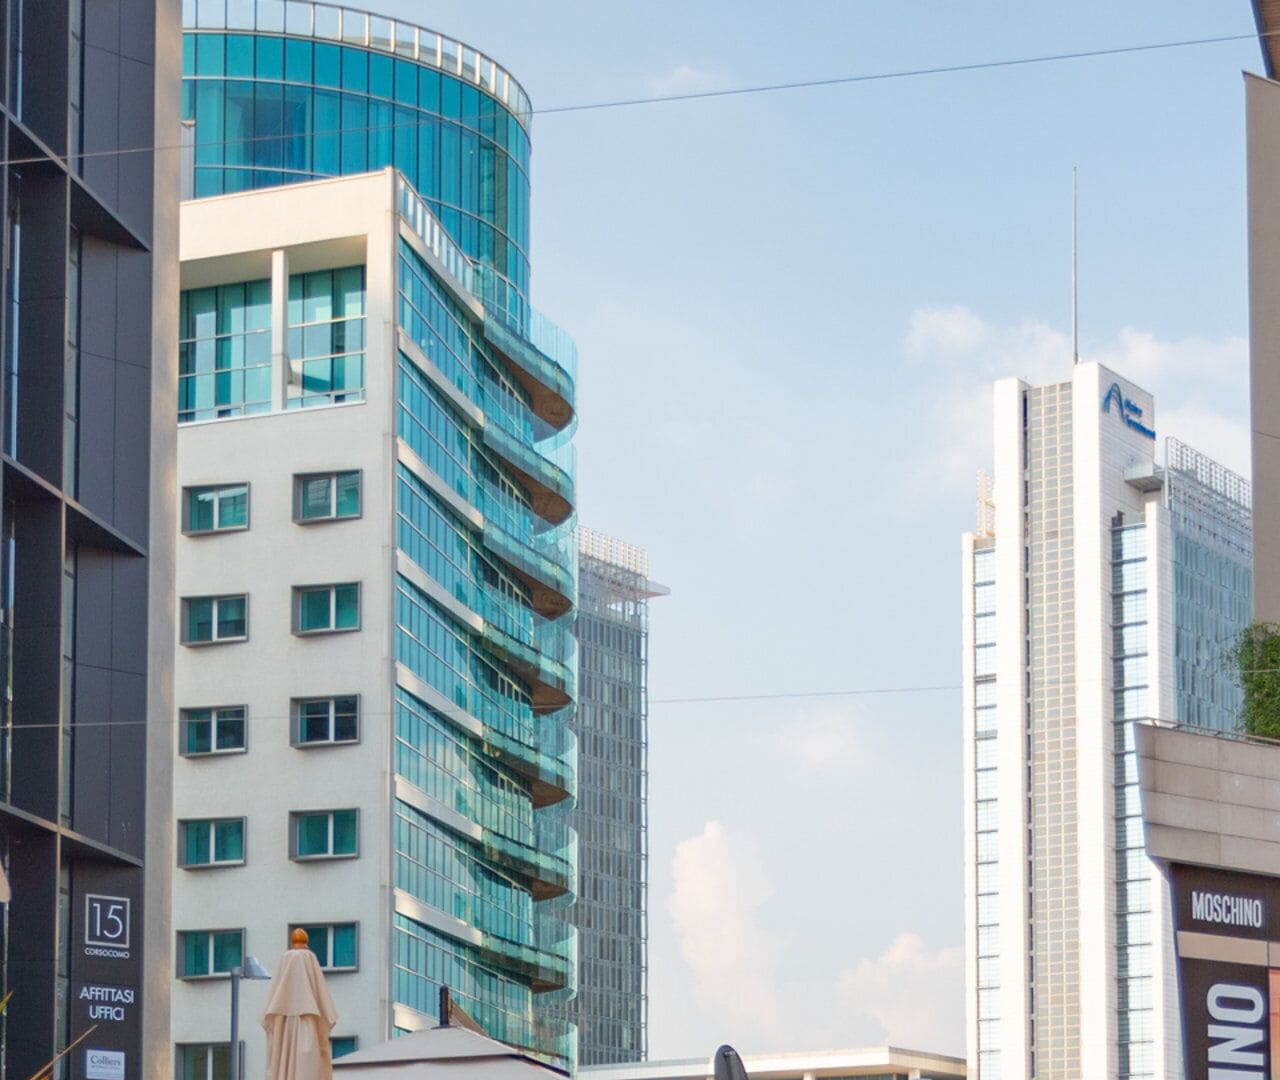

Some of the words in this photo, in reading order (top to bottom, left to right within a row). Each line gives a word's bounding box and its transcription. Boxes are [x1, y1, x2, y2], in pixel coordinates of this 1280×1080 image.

[1191, 890, 1263, 929] MOSCHINO
[92, 902, 124, 939] 15
[84, 948, 130, 959] CORSOCOMO
[79, 987, 134, 1004] AFFITTASI
[89, 1006, 125, 1021] UFFICI
